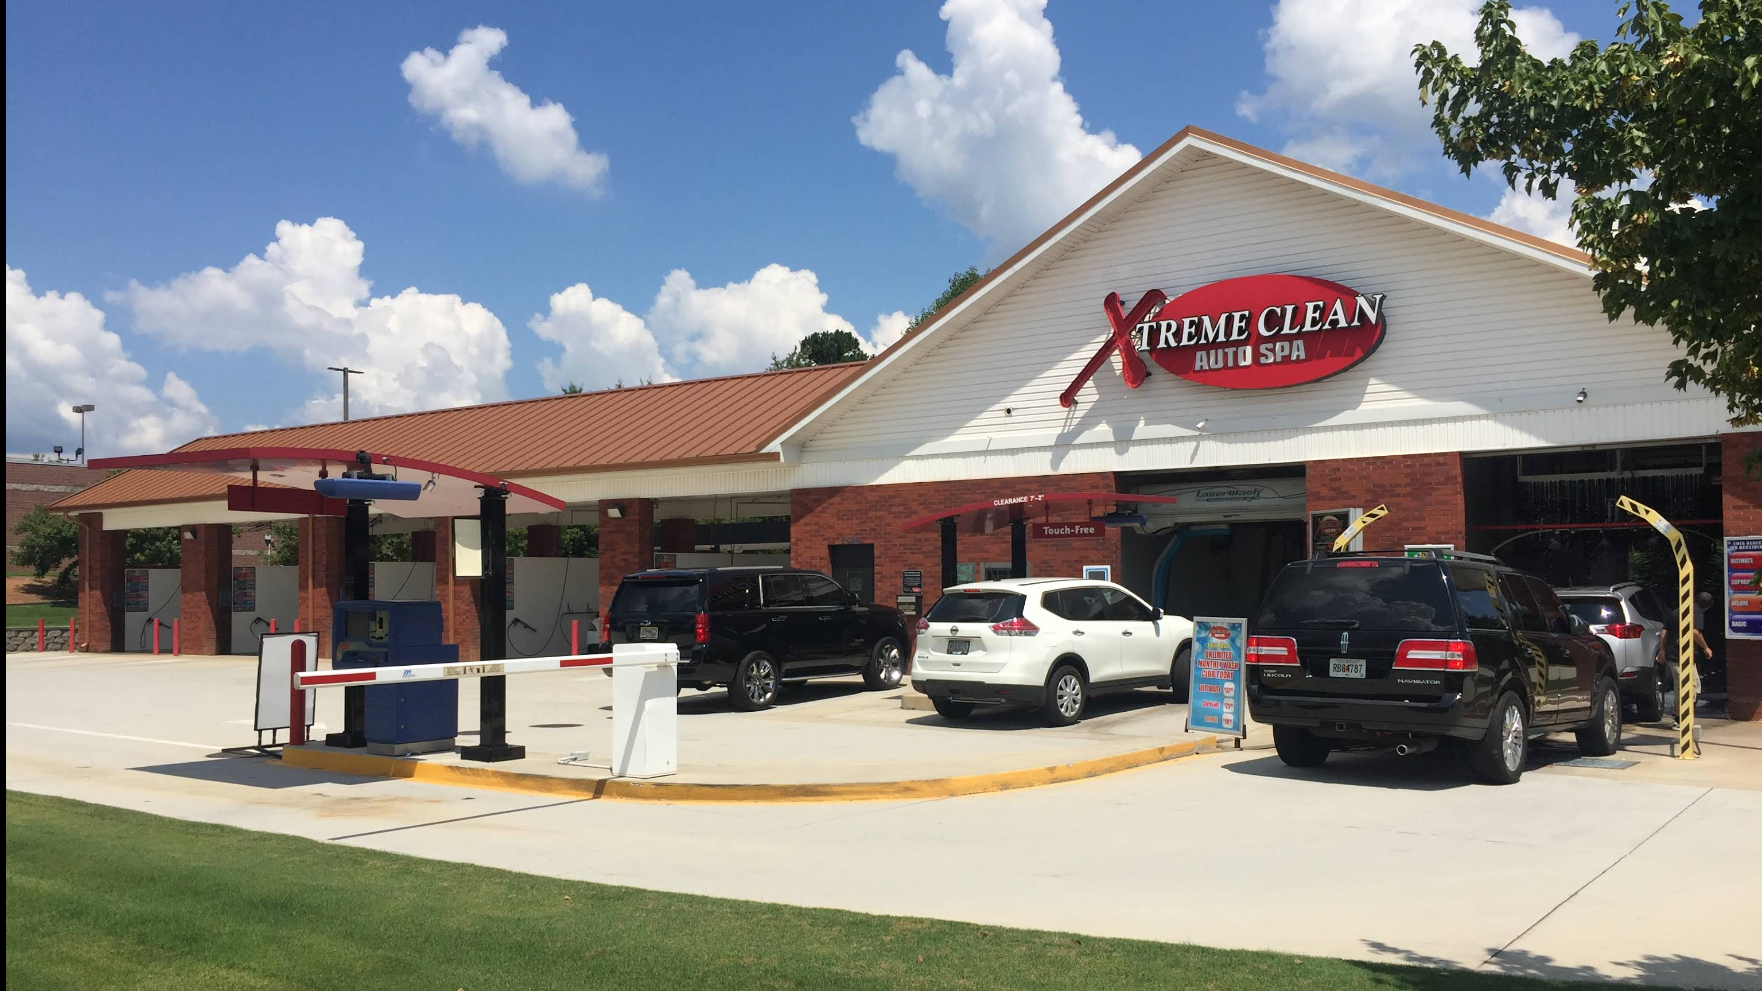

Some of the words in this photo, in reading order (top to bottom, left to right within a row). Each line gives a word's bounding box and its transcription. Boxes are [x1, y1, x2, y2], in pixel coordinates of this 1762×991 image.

[1257, 293, 1387, 337] CLEAN
[1195, 345, 1252, 371] AUTO
[1259, 339, 1307, 365] SPA
[993, 496, 1028, 506] CLEARANCE
[1043, 525, 1095, 535] Touch-Free
